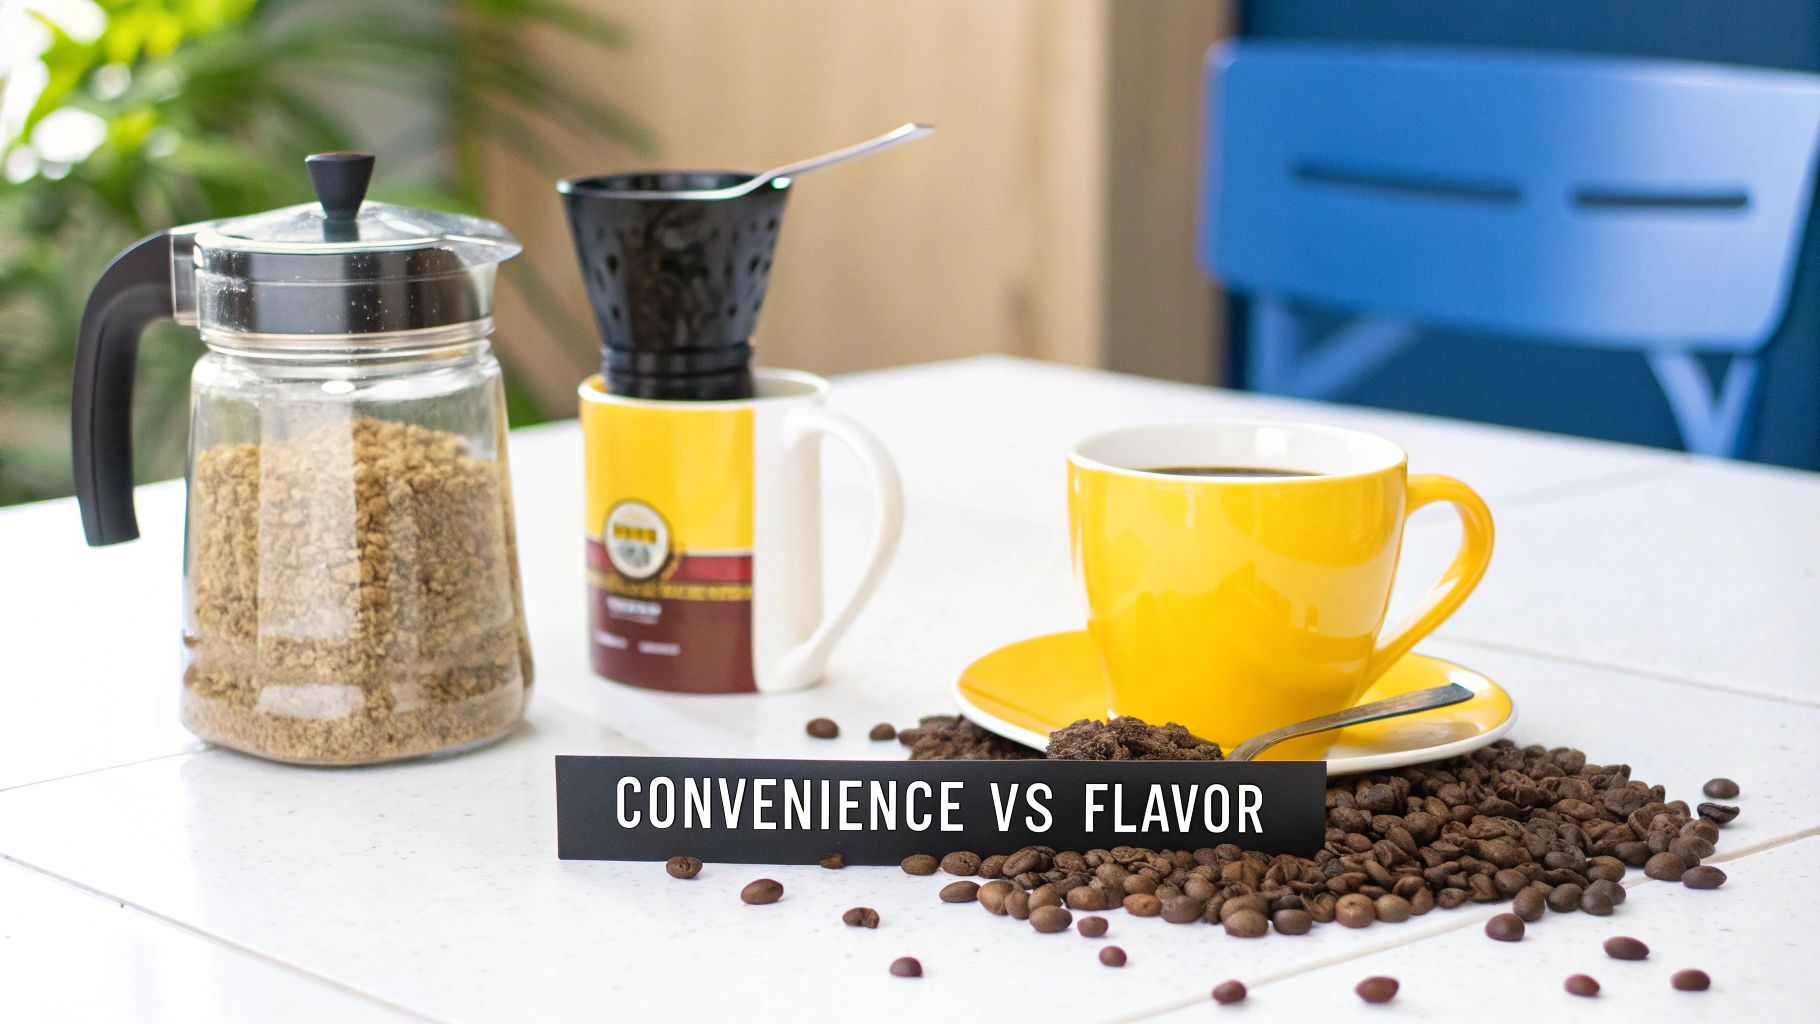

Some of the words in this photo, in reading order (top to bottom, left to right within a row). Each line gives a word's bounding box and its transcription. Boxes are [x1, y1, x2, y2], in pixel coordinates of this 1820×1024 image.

[615, 775, 965, 833] CONVENIENCE
[989, 781, 1054, 834] VS
[1084, 782, 1264, 835] FLAVOR
